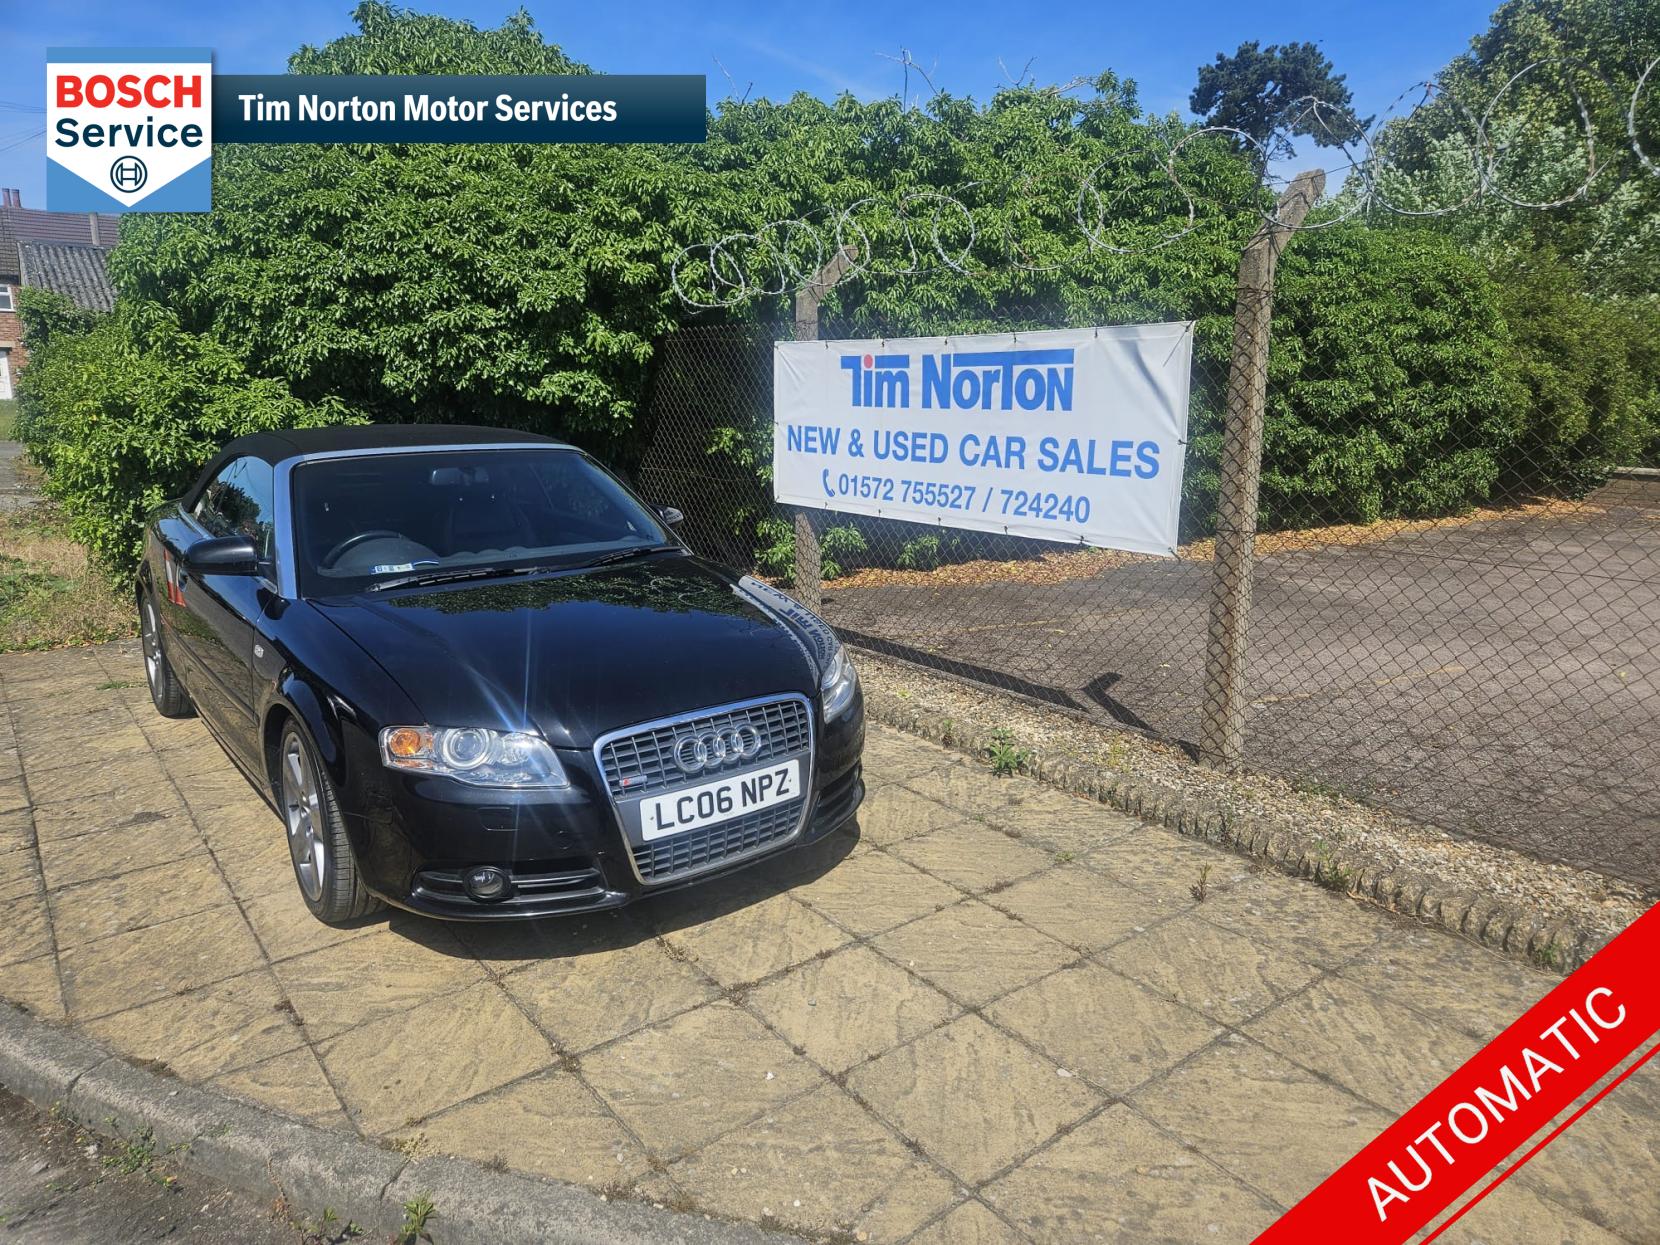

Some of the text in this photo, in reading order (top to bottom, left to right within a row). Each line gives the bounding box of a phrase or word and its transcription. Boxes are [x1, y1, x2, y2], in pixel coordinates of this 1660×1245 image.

[840, 354, 910, 409] Tim
[787, 424, 1161, 480] NEW & USED CAR SALES
[837, 473, 1091, 524] 01572 755527 / 724240
[655, 768, 790, 830] LC06 NPZ
